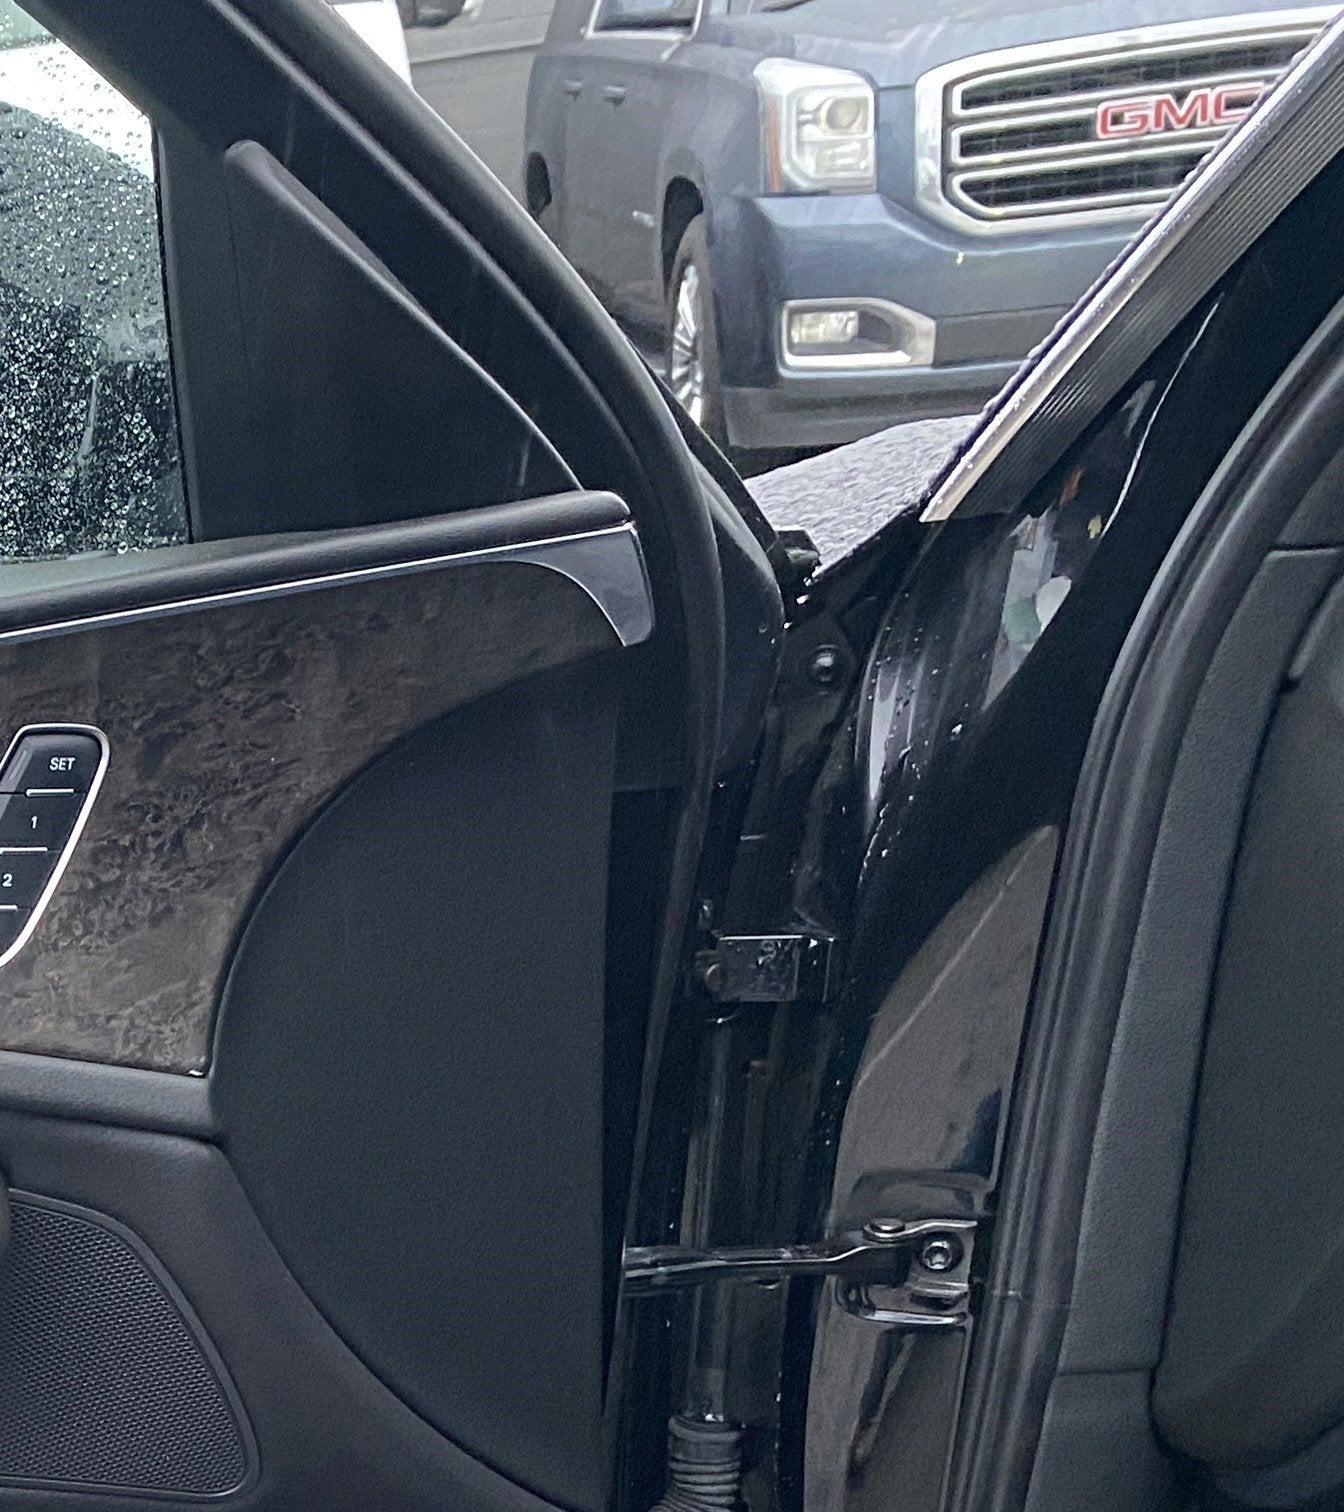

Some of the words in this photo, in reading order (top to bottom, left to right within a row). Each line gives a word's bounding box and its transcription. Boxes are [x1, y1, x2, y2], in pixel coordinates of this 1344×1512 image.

[1096, 82, 1264, 138] GMC
[49, 757, 76, 771] SET
[31, 816, 38, 829] 1
[2, 873, 13, 887] 2
